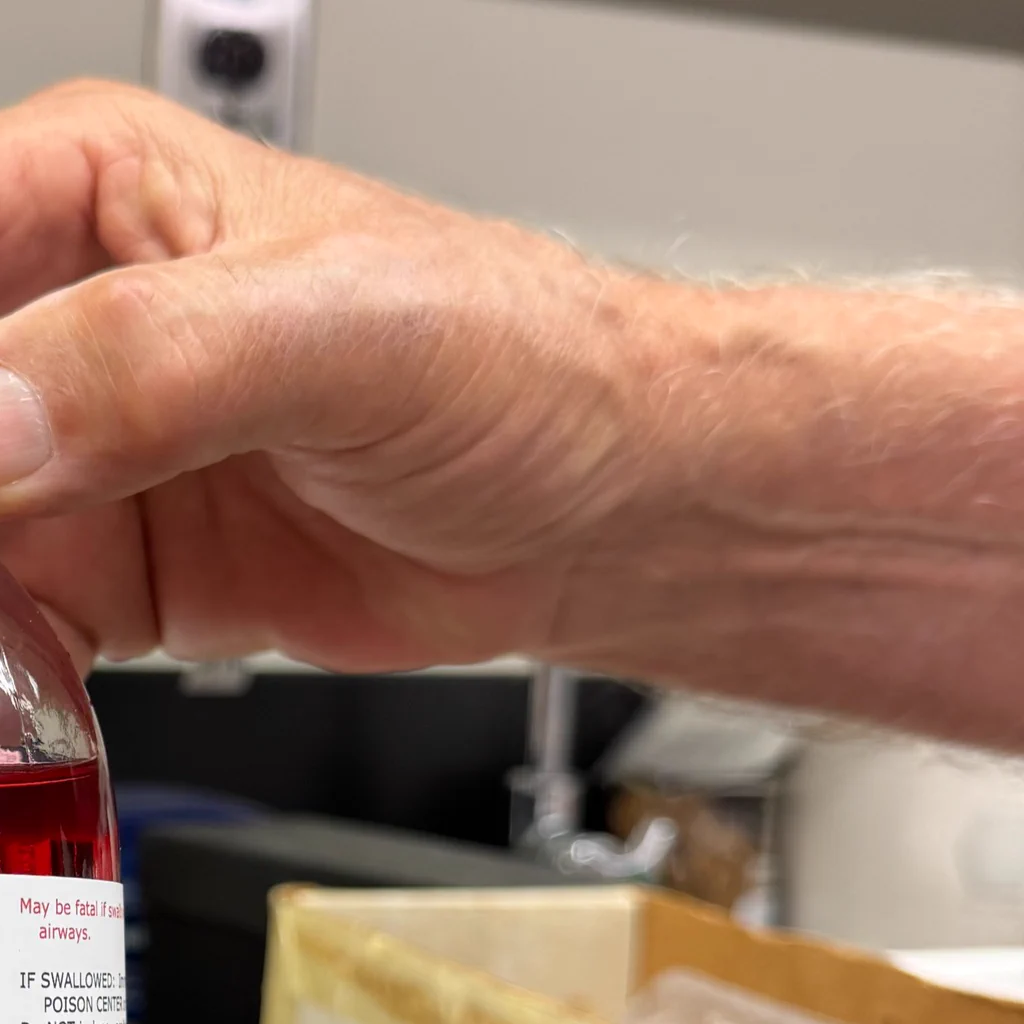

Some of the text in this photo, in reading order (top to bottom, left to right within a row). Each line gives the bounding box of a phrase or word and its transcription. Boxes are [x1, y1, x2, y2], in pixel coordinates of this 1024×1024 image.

[20, 898, 49, 917] May
[56, 899, 71, 915] be
[75, 899, 98, 916] fatal
[101, 901, 106, 917] if
[39, 924, 91, 944] airways.
[20, 972, 36, 988] IF
[41, 972, 115, 989] SWALLOWED:
[44, 997, 93, 1012] POISON
